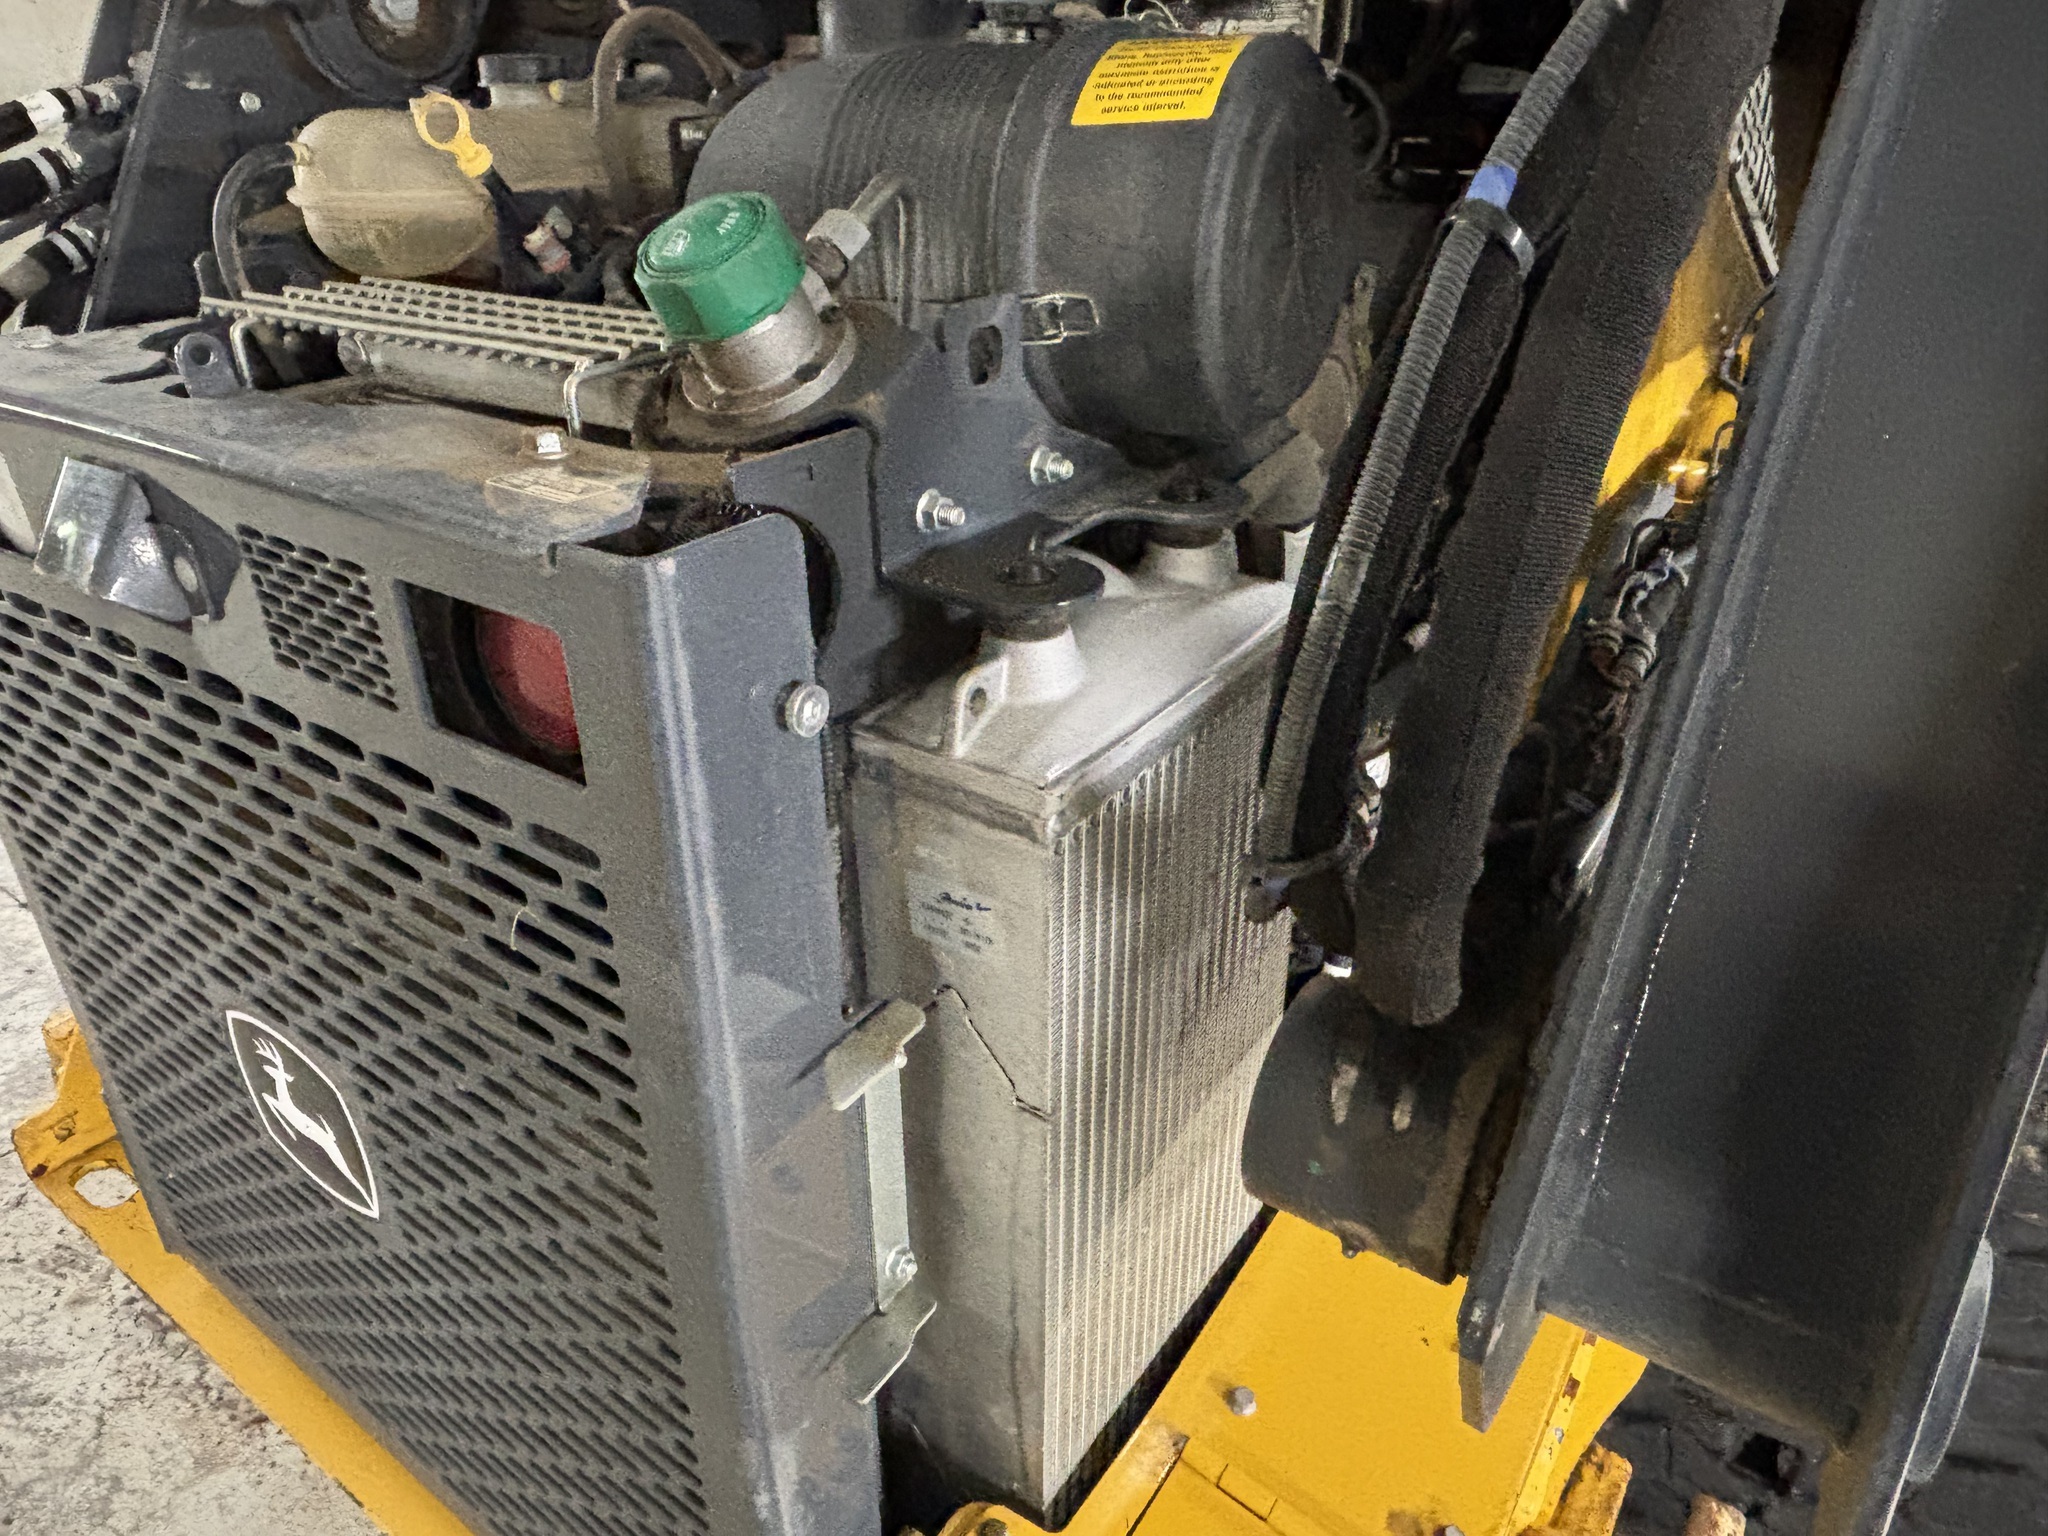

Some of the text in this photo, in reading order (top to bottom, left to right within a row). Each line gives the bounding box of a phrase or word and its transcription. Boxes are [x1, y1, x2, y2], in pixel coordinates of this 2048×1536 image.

[1095, 87, 1205, 102] to the recommended
[1101, 101, 1186, 114] service interval.
